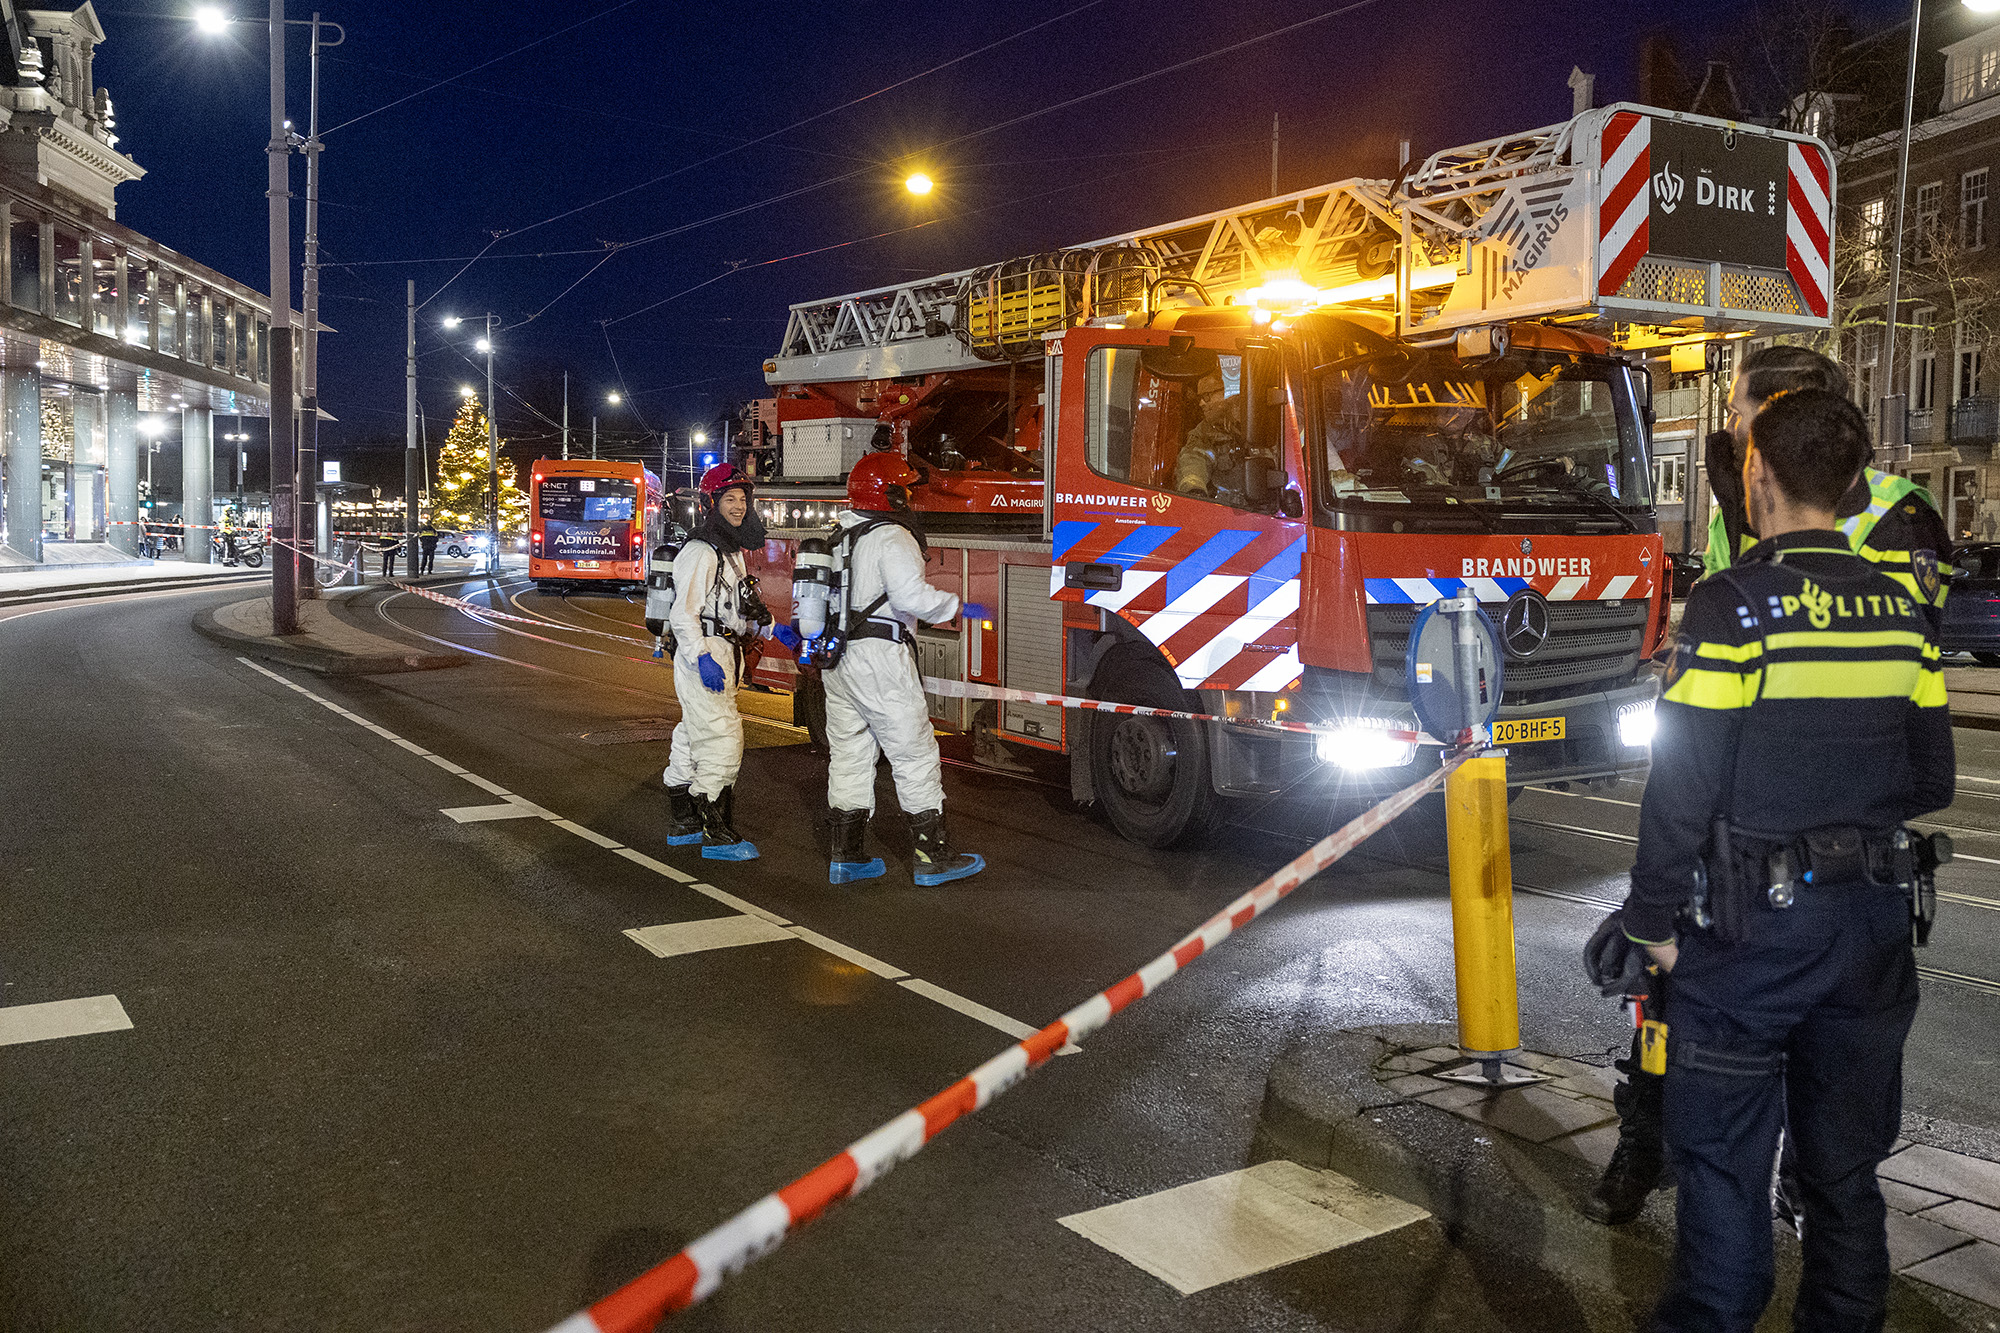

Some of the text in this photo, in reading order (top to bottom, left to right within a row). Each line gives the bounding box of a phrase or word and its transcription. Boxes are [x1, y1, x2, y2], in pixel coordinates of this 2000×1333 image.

[1696, 176, 1755, 213] DIRK
[1502, 203, 1569, 301] MAGIRUS
[1147, 378, 1160, 408] 251
[1010, 498, 1043, 508] MAGIRU
[1056, 492, 1147, 508] BRANDWEER
[554, 535, 621, 547] ADMIRAL
[1462, 557, 1592, 577] BRANDWEER
[1781, 578, 1911, 629] POLITIE
[1496, 720, 1561, 741] 20-BHF-5
